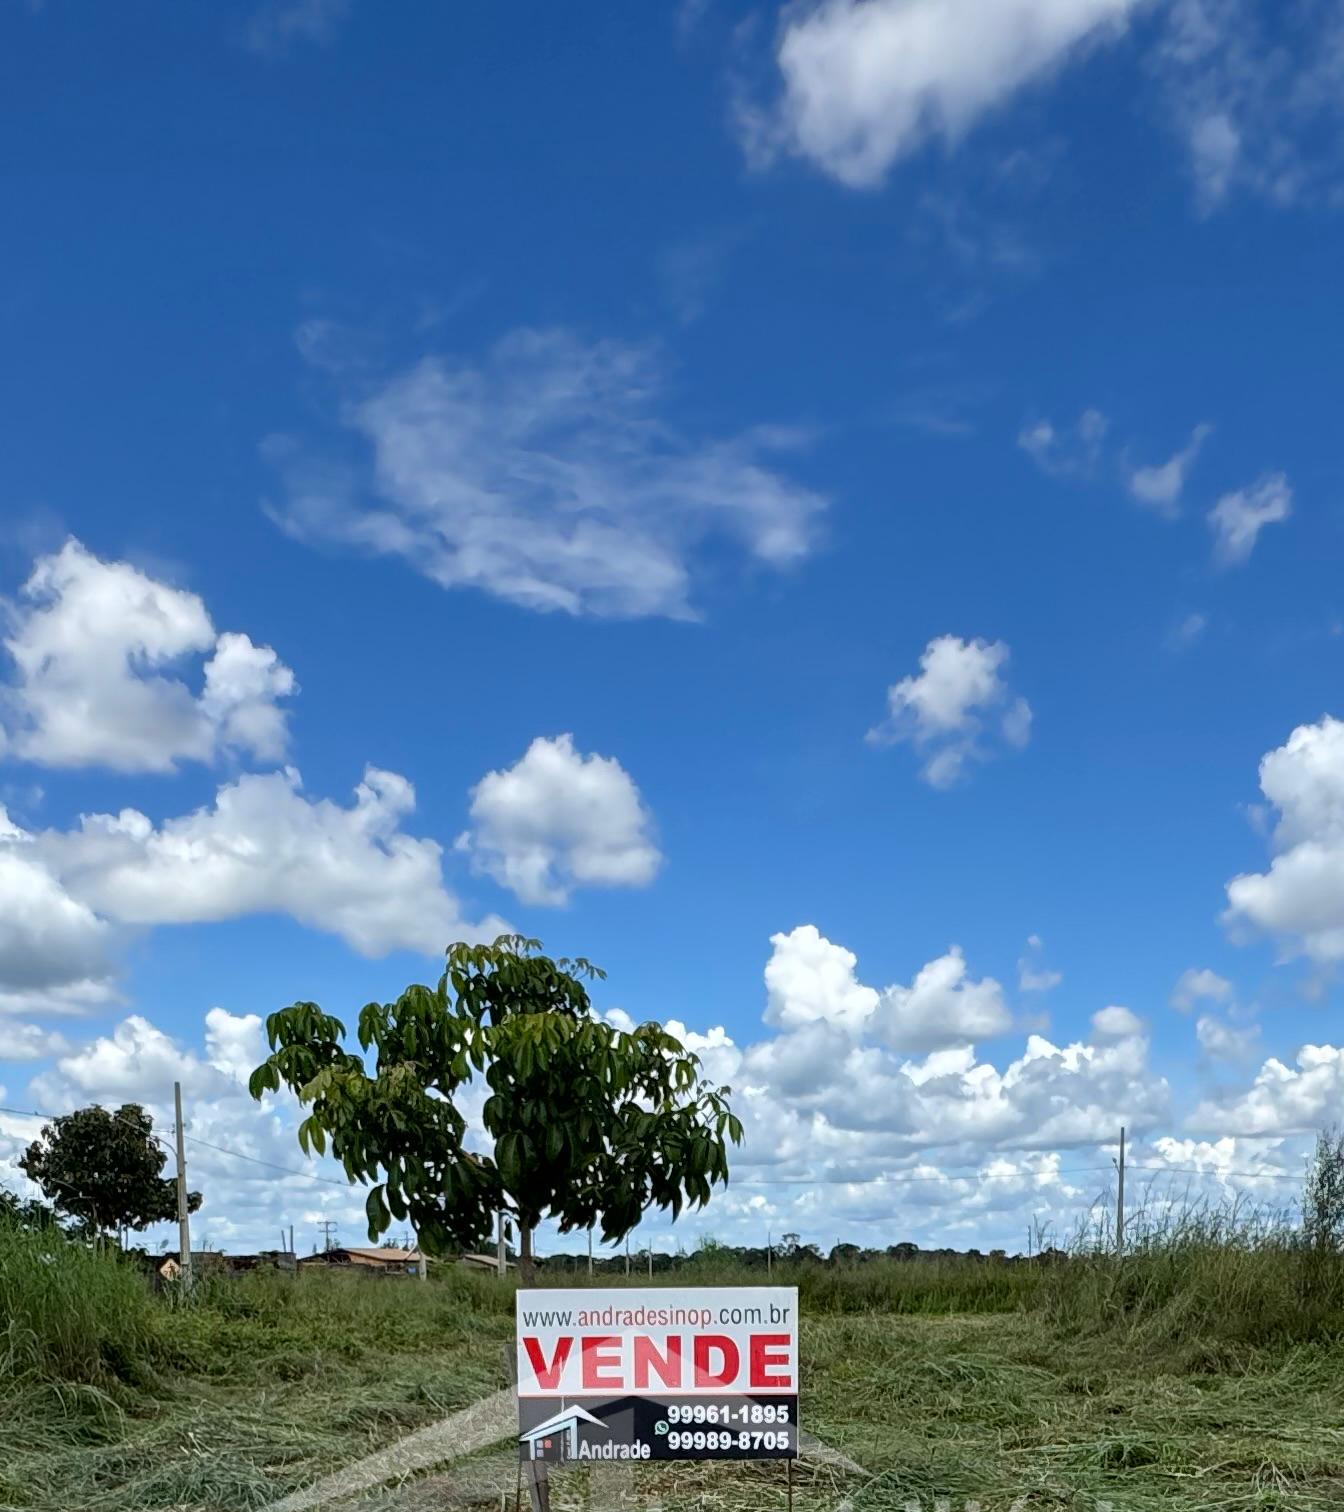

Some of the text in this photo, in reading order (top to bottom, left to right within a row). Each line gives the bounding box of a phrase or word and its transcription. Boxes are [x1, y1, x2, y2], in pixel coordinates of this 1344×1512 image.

[522, 1303, 791, 1329] www.andradesinop.com.br
[522, 1334, 792, 1389] VENDE
[667, 1405, 789, 1424] 99961-1895
[578, 1439, 651, 1459] Andrade
[667, 1431, 789, 1450] 99989-8705
